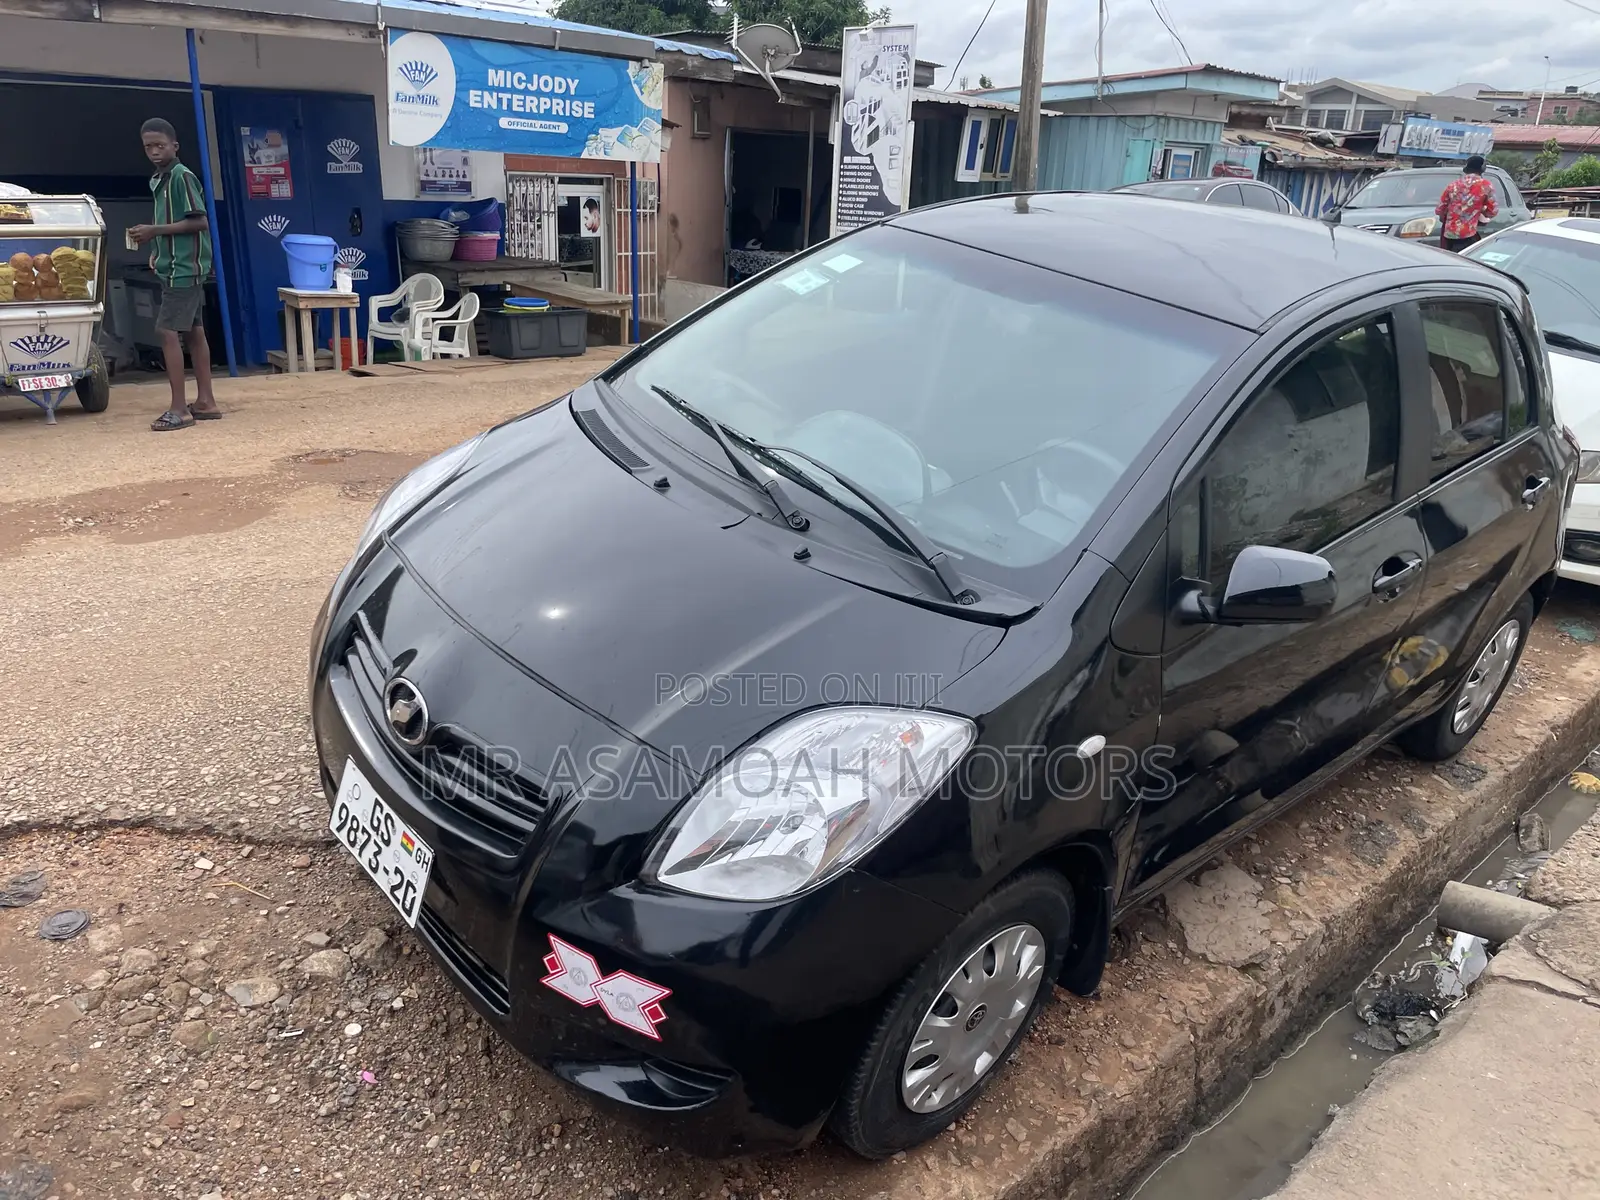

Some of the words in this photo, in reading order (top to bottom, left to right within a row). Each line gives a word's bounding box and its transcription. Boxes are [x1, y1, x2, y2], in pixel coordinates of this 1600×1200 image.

[882, 44, 909, 52] SYSTEM
[410, 70, 426, 82] FAN
[488, 68, 579, 96] MICJODY
[469, 89, 595, 119] ENTERPRISE
[507, 120, 537, 129] OFFICIAL
[539, 122, 561, 131] AGENT
[338, 147, 350, 155] FAN
[269, 222, 281, 231] FAN
[345, 255, 356, 263] FAN
[29, 342, 52, 351] FAN
[370, 797, 395, 848] GS
[335, 802, 417, 918] 9873-20
[415, 847, 430, 873] GH
